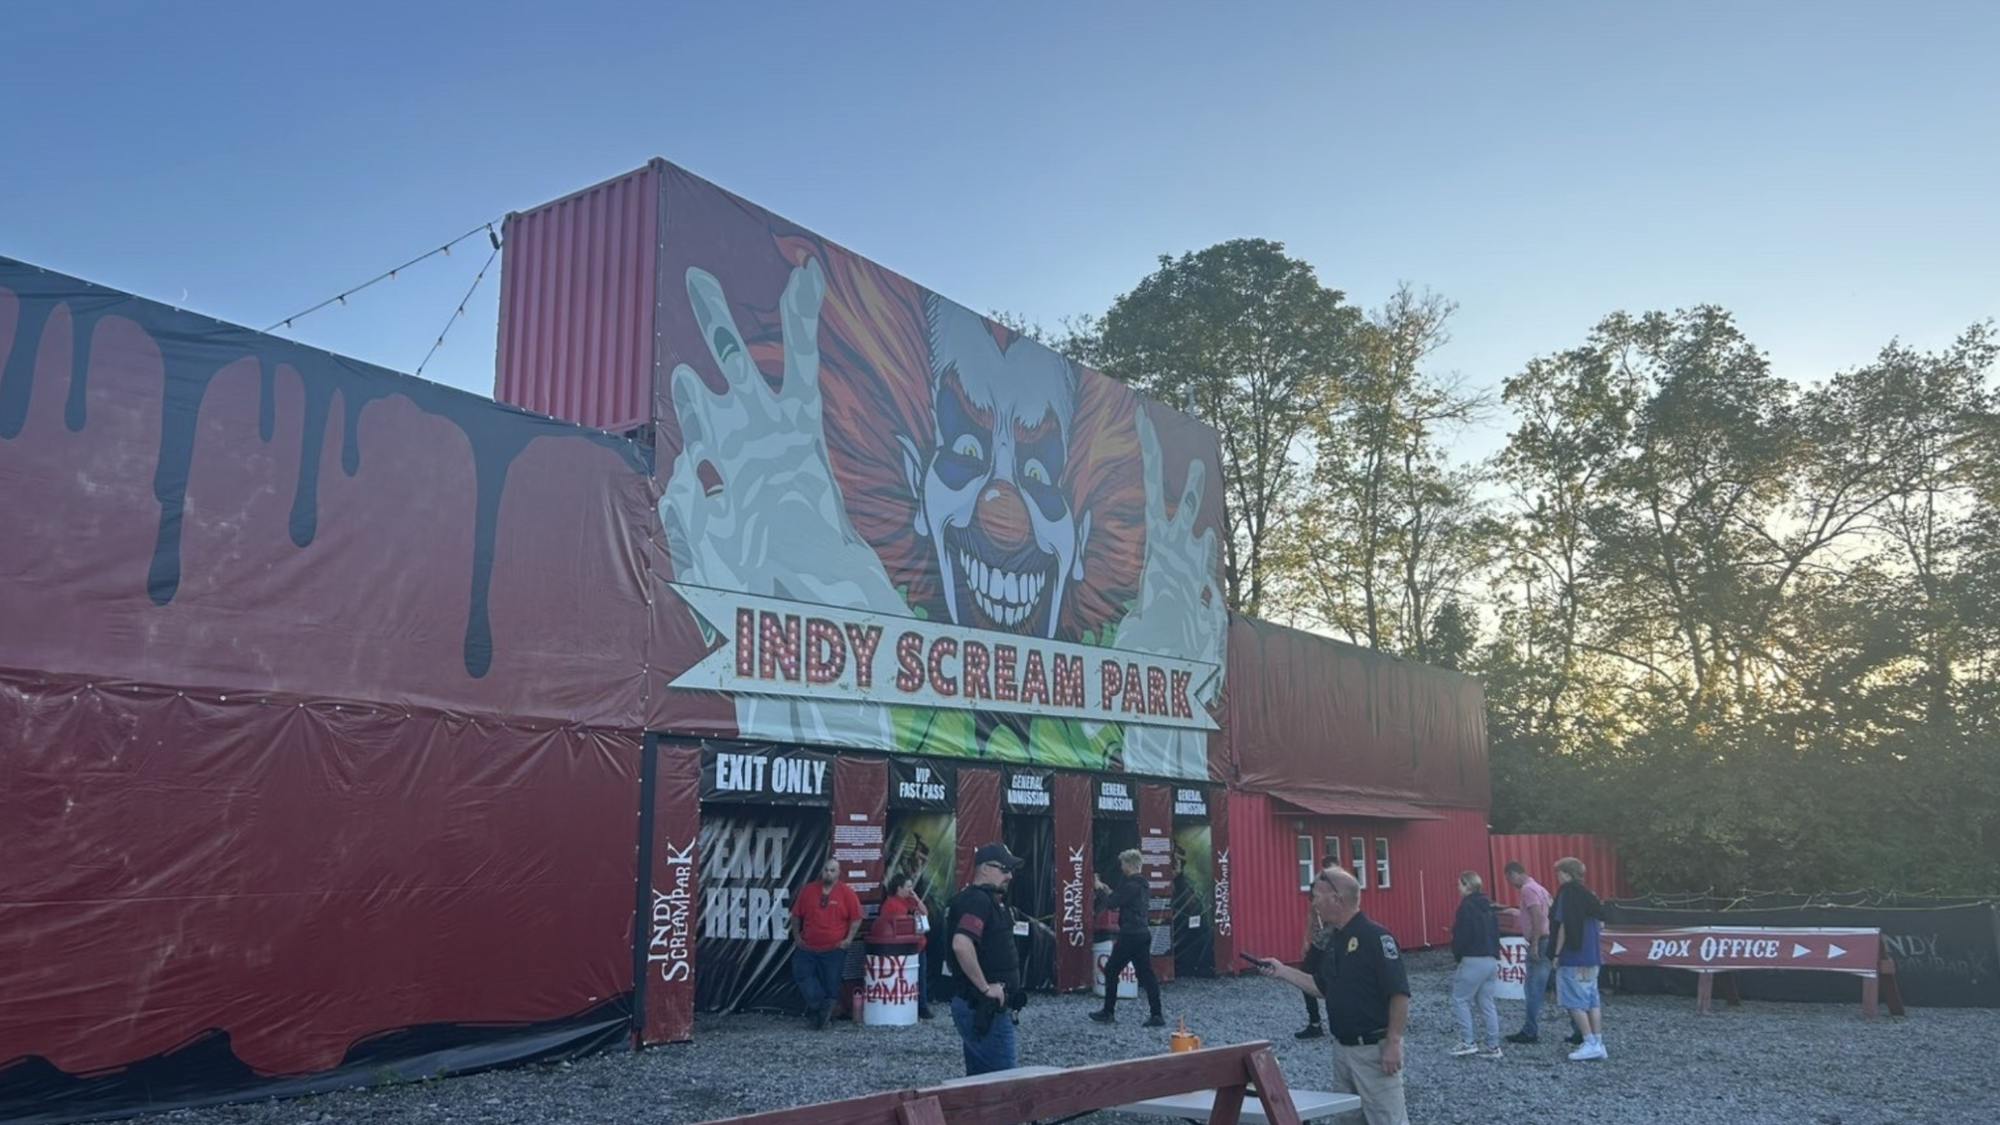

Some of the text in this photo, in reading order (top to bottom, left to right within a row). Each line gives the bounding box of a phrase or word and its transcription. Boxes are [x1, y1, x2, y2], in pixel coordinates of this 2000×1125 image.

[736, 606, 1193, 719] INDY SCREAM PARK
[715, 752, 827, 795] EXIT ONLY
[915, 767, 932, 784] VIP
[1011, 774, 1044, 791] GENERAL
[900, 782, 946, 801] FAST PASS
[1007, 789, 1050, 806] ADMISSION
[711, 827, 789, 880] EXIT
[705, 887, 790, 940] HERE
[1062, 879, 1076, 932] INDY
[648, 889, 672, 962] INDY
[1647, 936, 1780, 962] BOX OFFICE
[1881, 932, 1939, 957] NDY
[865, 954, 908, 980] NDY
